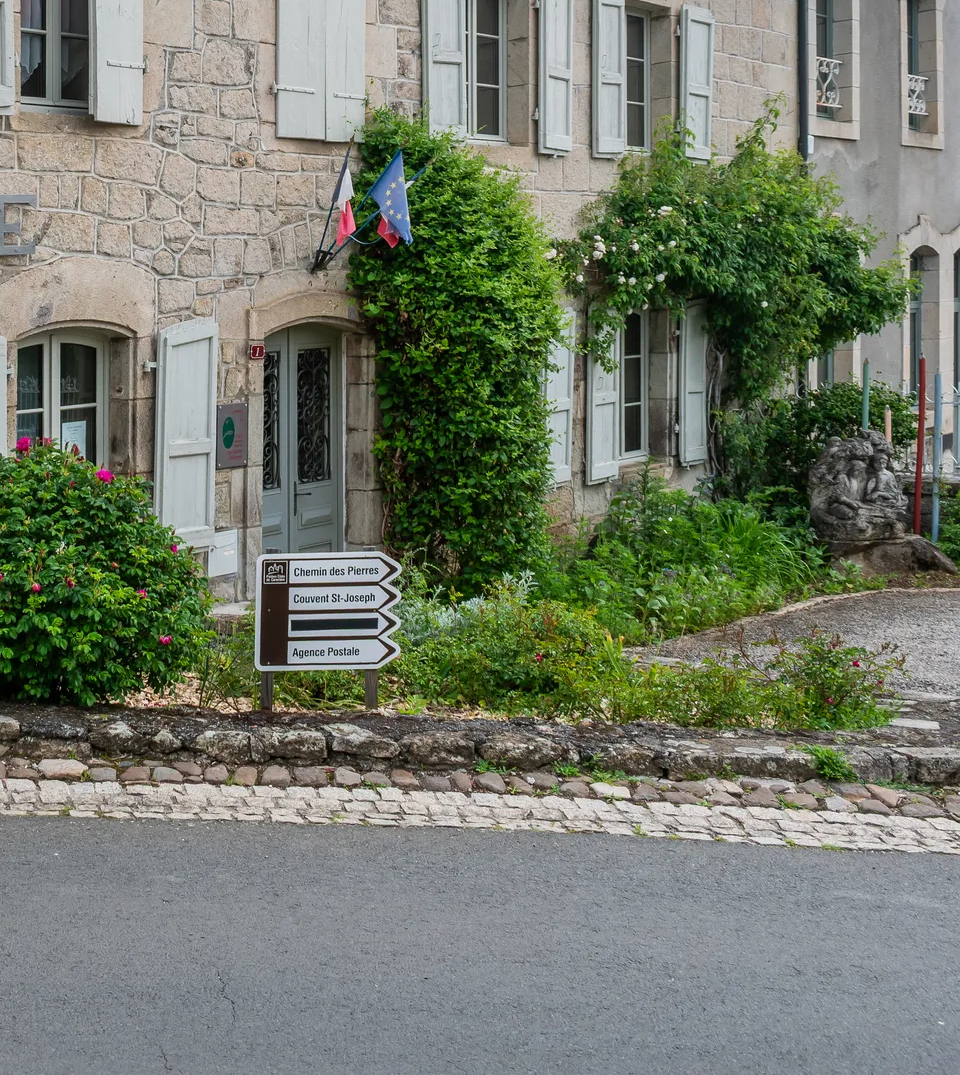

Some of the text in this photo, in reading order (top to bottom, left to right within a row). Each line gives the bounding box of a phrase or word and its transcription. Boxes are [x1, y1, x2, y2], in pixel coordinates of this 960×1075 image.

[293, 565, 379, 577] Chemin des Pierres
[293, 592, 376, 604] Couvent St-Joseph
[292, 646, 360, 659] Agence Postale
